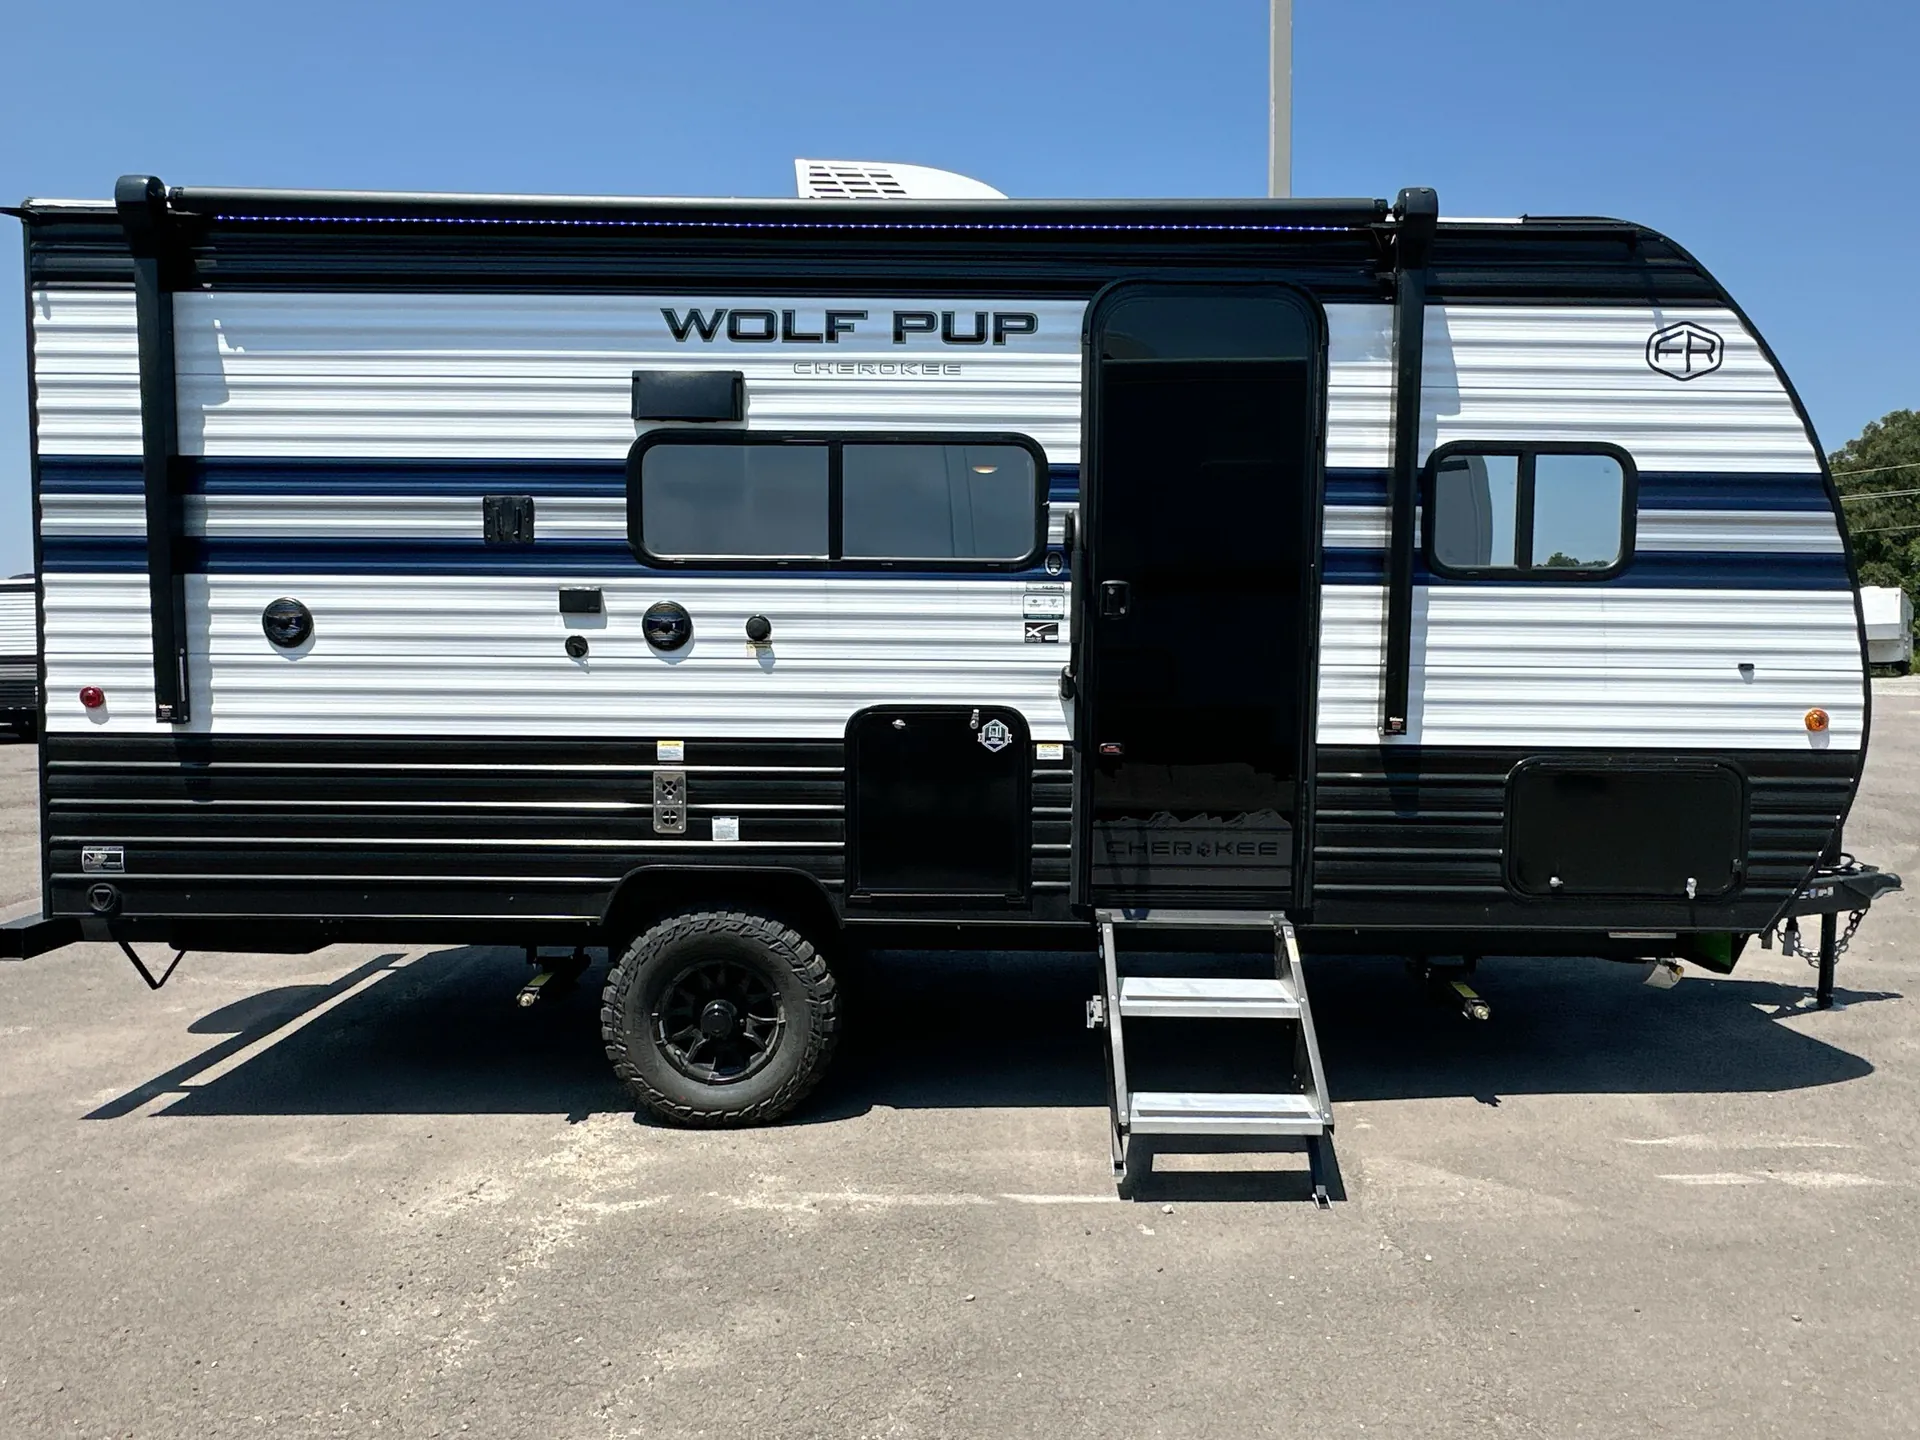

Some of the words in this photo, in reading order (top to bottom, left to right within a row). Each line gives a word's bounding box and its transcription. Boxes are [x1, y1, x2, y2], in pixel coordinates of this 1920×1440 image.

[660, 308, 868, 343] WOLF
[893, 311, 1038, 345] PUP
[793, 361, 962, 376] CHEROKEE
